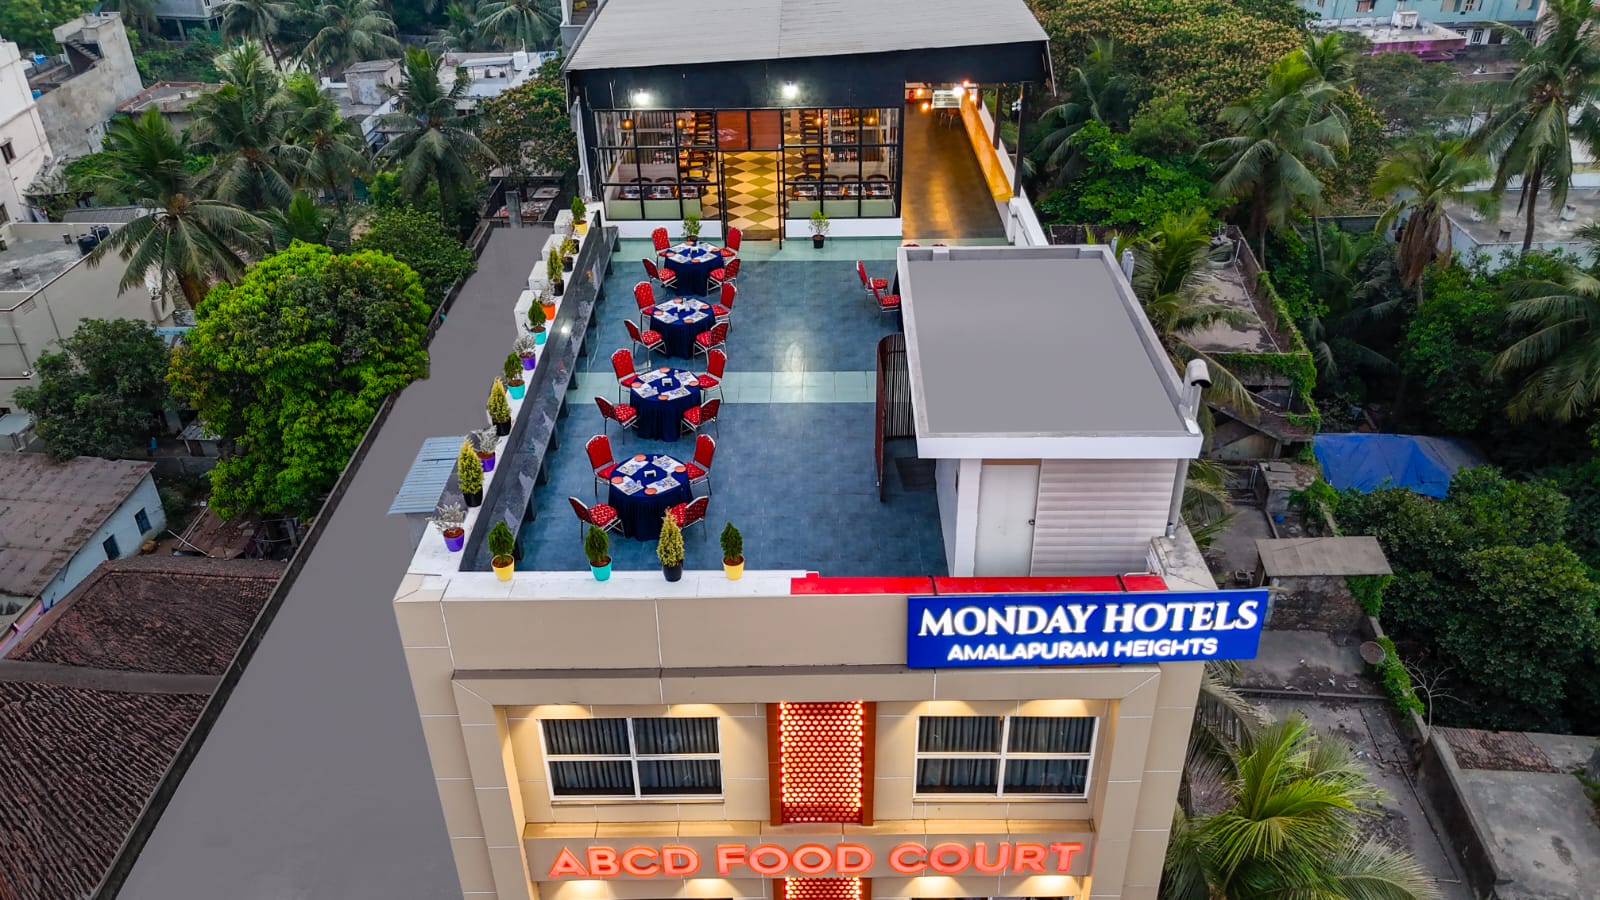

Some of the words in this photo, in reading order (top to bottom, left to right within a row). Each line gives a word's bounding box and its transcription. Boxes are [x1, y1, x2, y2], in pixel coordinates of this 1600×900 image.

[918, 603, 1098, 637] MONDAY
[1102, 599, 1259, 633] HOTELS
[947, 641, 1109, 661] AMALAPURAM
[1113, 637, 1218, 658] HEIGHTS
[549, 845, 701, 879] ABCD
[715, 842, 874, 876] FOOD
[888, 841, 1082, 874] COURT
